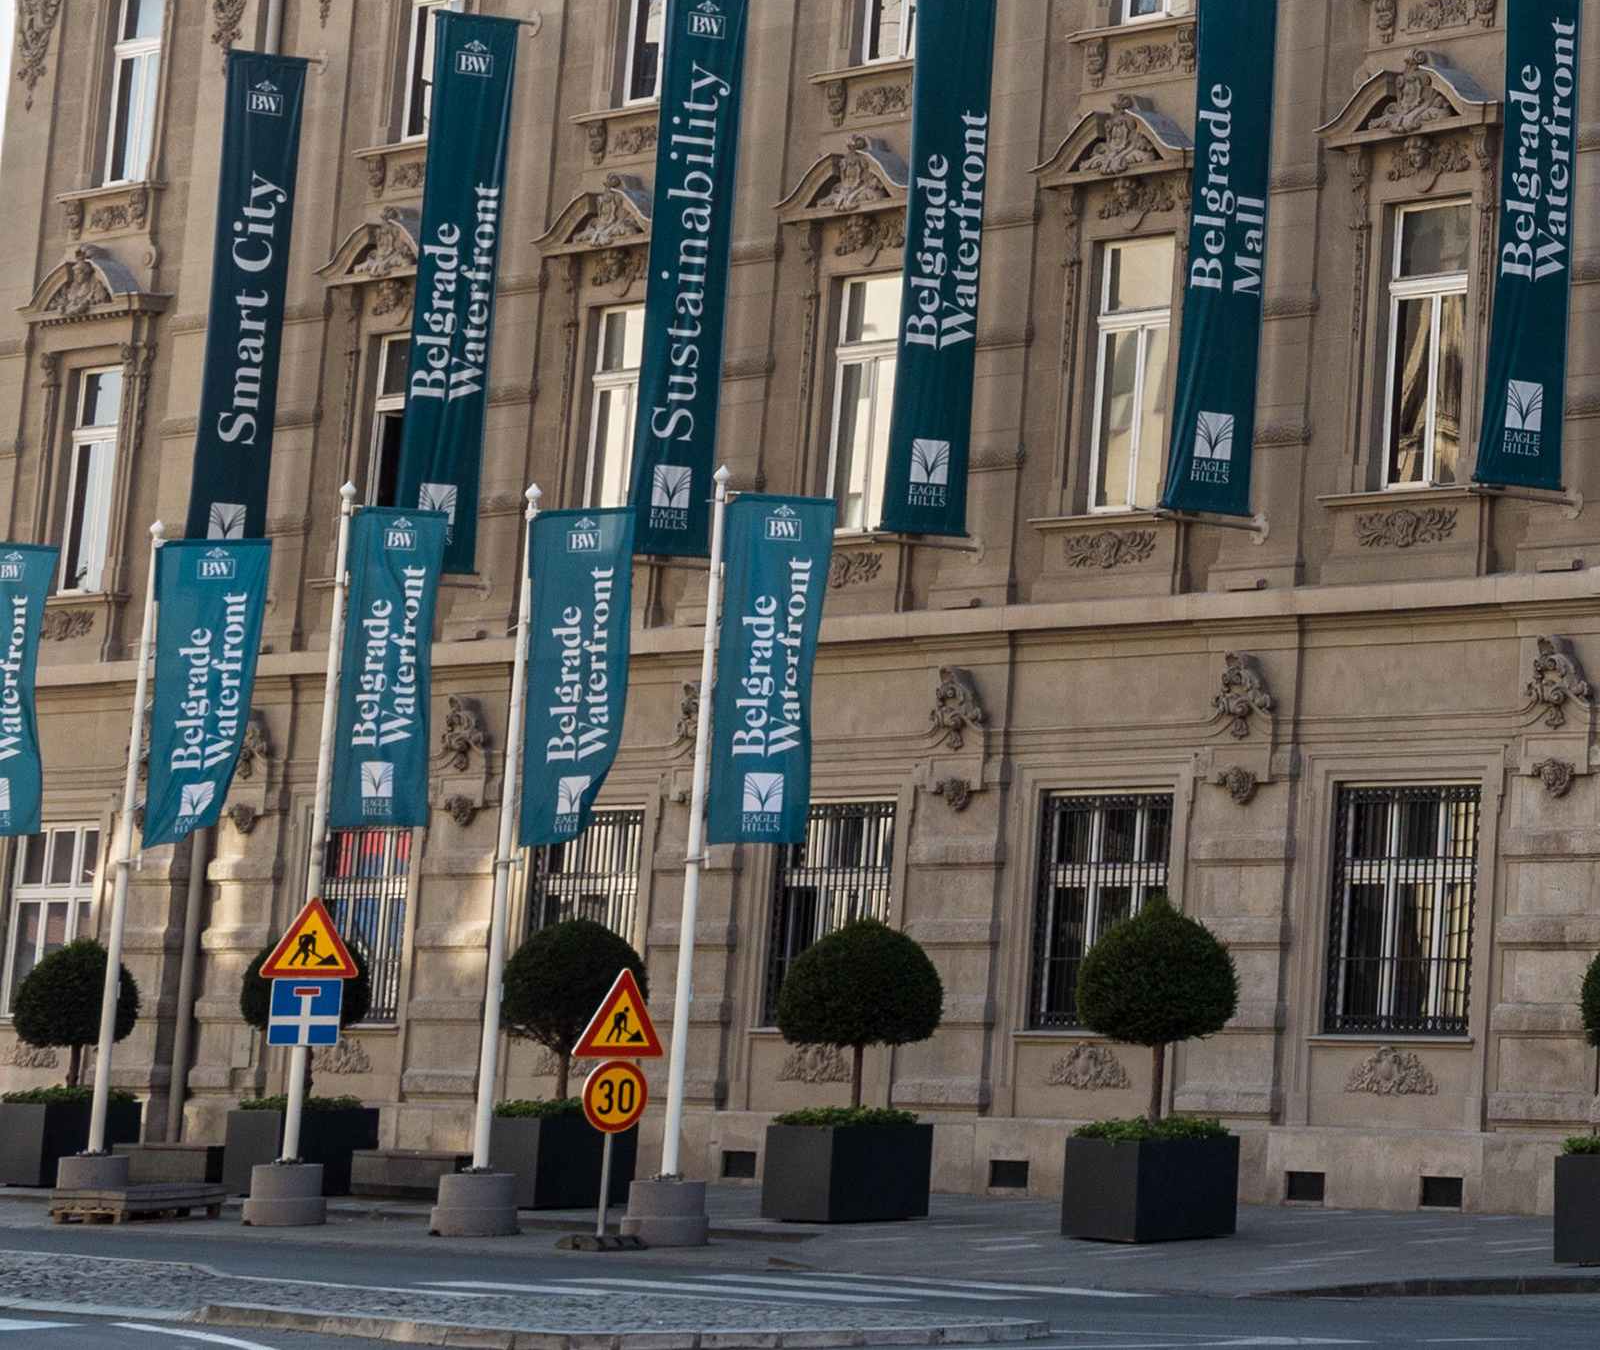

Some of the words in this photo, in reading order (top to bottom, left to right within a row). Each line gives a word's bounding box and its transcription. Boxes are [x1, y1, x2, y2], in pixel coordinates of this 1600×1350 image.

[692, 14, 721, 36] BW
[460, 53, 489, 74] BW
[251, 93, 281, 114] BW
[1535, 16, 1575, 280] Waterfront
[1190, 83, 1234, 290] Belgrade
[1501, 64, 1541, 281] Belgrade
[232, 169, 286, 273] City
[940, 109, 988, 349] Waterfront
[652, 59, 729, 442] Sustainability
[905, 153, 949, 350] Belgrade
[1233, 195, 1264, 293] Mall
[410, 222, 461, 400] Belgrade
[448, 182, 499, 402] Waterfront
[217, 287, 268, 446] Smart
[1502, 442, 1541, 457] HILLS
[1504, 430, 1542, 444] EAGLE
[1189, 471, 1230, 484] HILLS
[1191, 459, 1231, 473] EAGLE
[907, 496, 947, 508] HILLS
[908, 484, 947, 497] EAGLE
[648, 519, 688, 531] HILLS
[650, 508, 689, 521] EAGLE
[769, 517, 798, 539] BW
[387, 527, 414, 548] BW
[570, 530, 598, 550] BW
[201, 558, 231, 578] BW
[352, 598, 392, 746] Belgrade
[380, 565, 426, 745] Waterfront
[578, 566, 614, 760] Waterfront
[768, 556, 812, 756] Waterfront
[204, 592, 247, 769] Waterfront
[547, 606, 582, 762] Belgrade
[732, 595, 777, 756] Belgrade
[171, 627, 212, 771] Belgrade
[361, 807, 392, 816] HILLS
[362, 799, 393, 808] EAGLE
[743, 815, 782, 825] EAGLE
[742, 823, 781, 834] HILLS
[596, 1078, 636, 1116] 30
